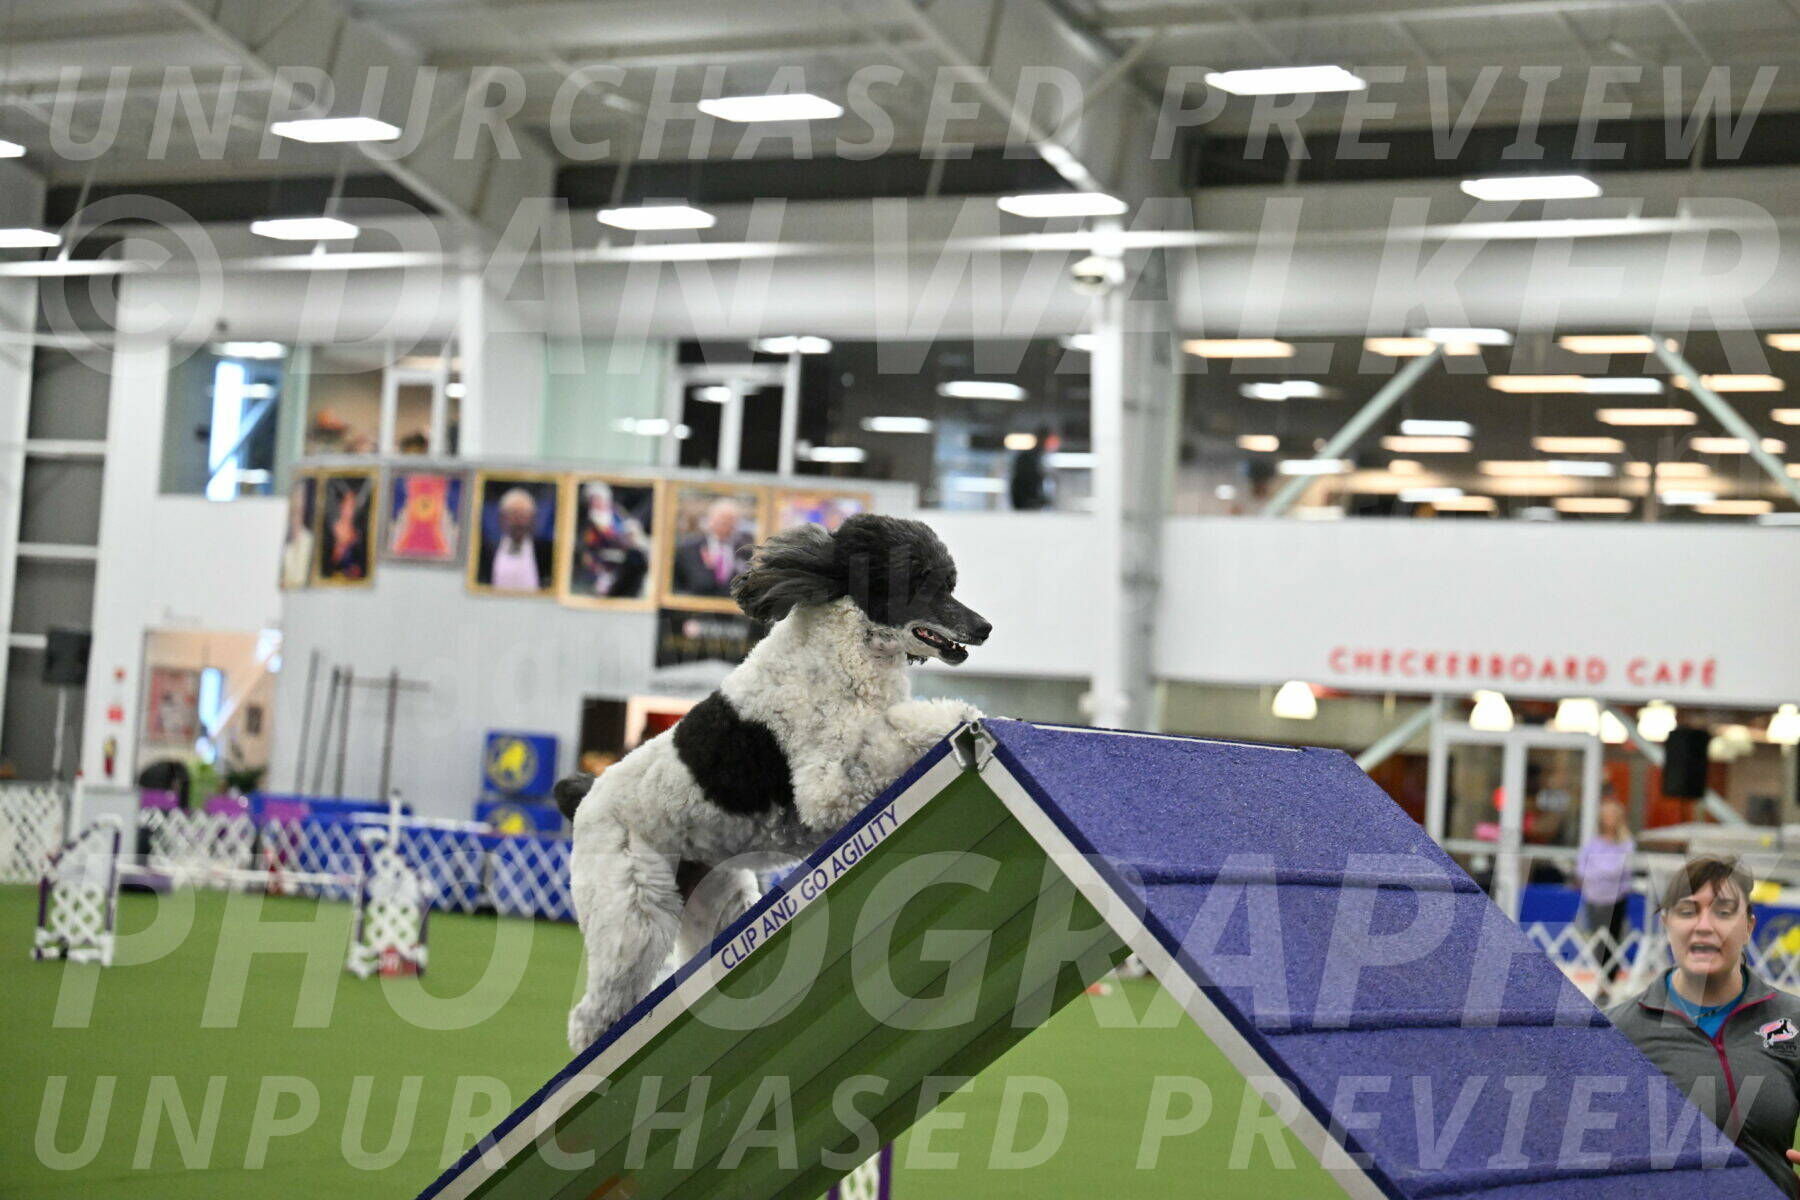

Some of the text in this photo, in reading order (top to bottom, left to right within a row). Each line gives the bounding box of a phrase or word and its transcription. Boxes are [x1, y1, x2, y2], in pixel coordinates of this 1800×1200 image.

[1327, 647, 1718, 687] CHECKERBOARD CAFÉ
[721, 804, 899, 969] CLIP AND GO AGILITY
